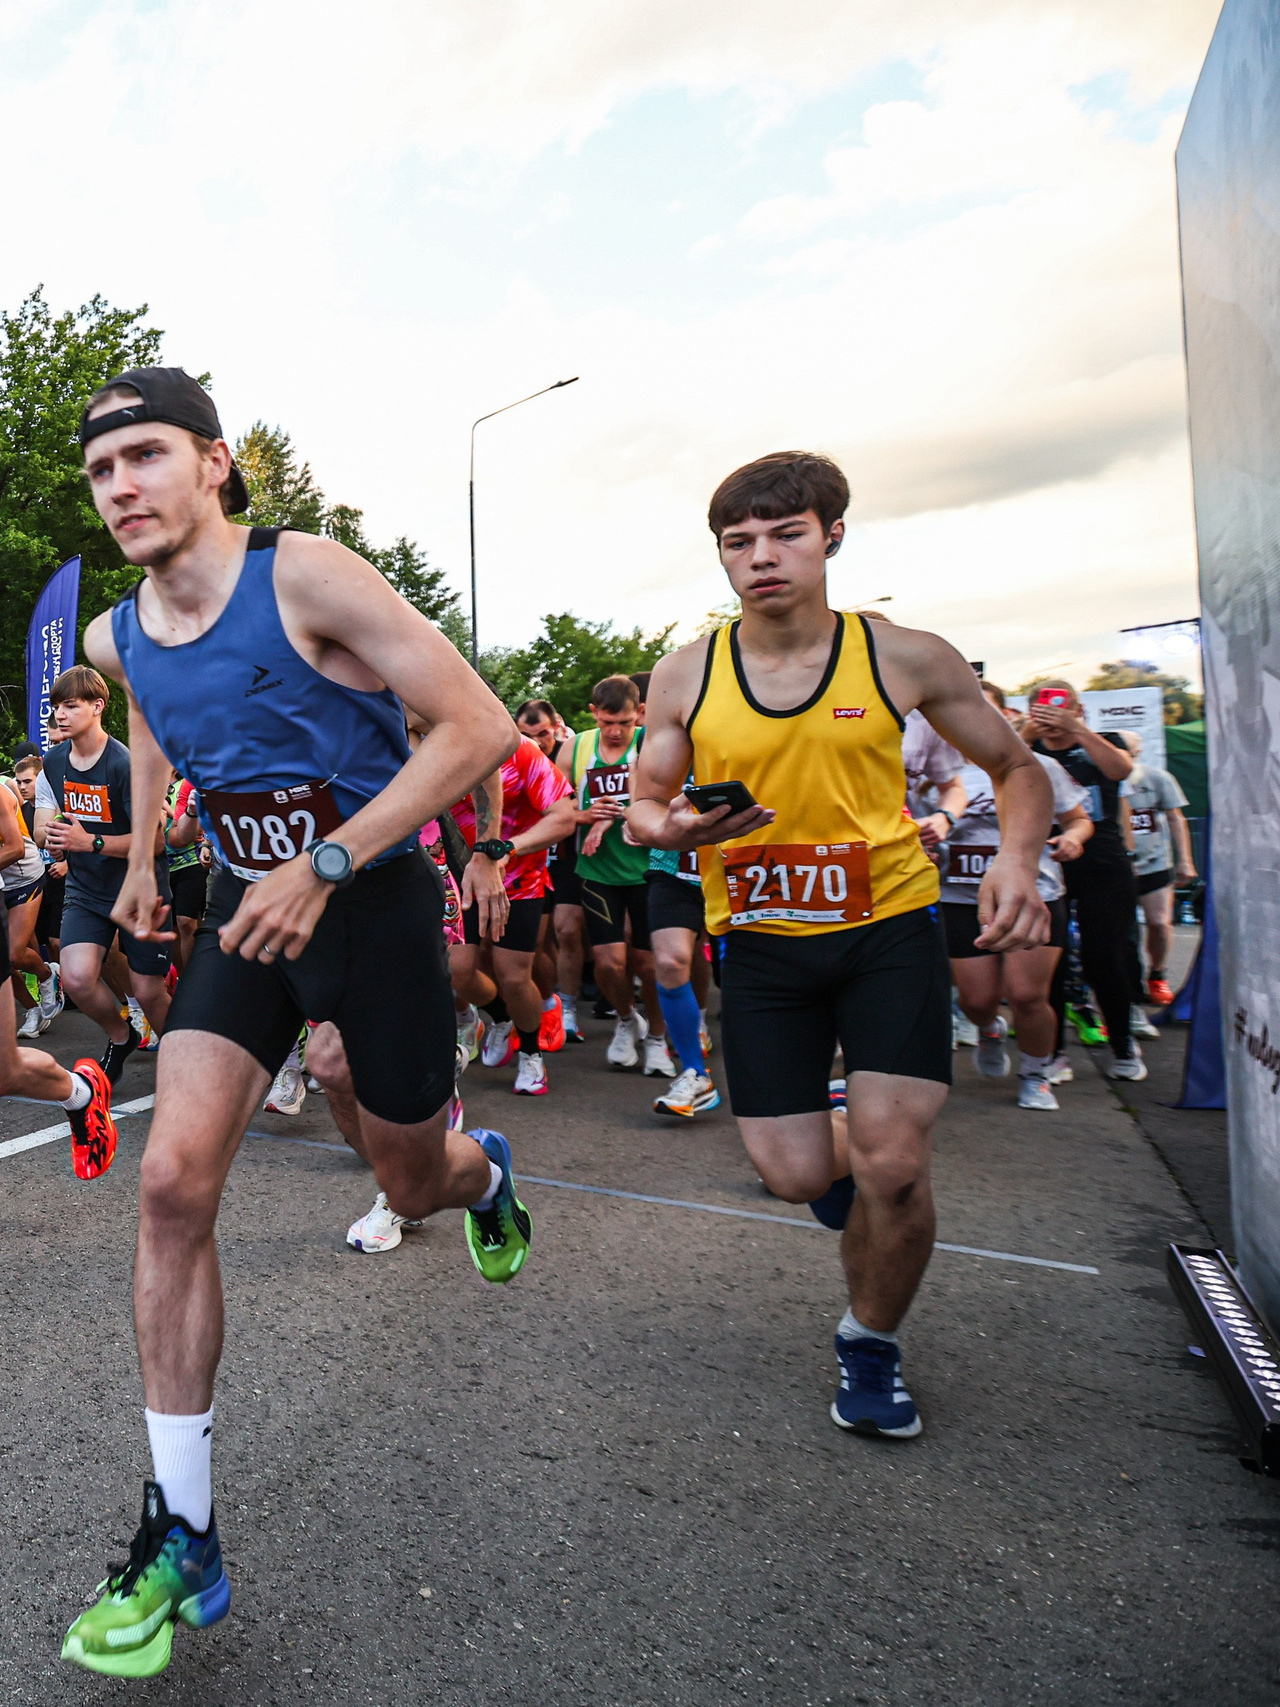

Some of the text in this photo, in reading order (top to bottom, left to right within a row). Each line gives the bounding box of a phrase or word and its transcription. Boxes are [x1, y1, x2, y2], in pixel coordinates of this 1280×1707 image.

[69, 791, 102, 813] 0458
[220, 809, 316, 861] 1282
[745, 864, 848, 903] 2170
